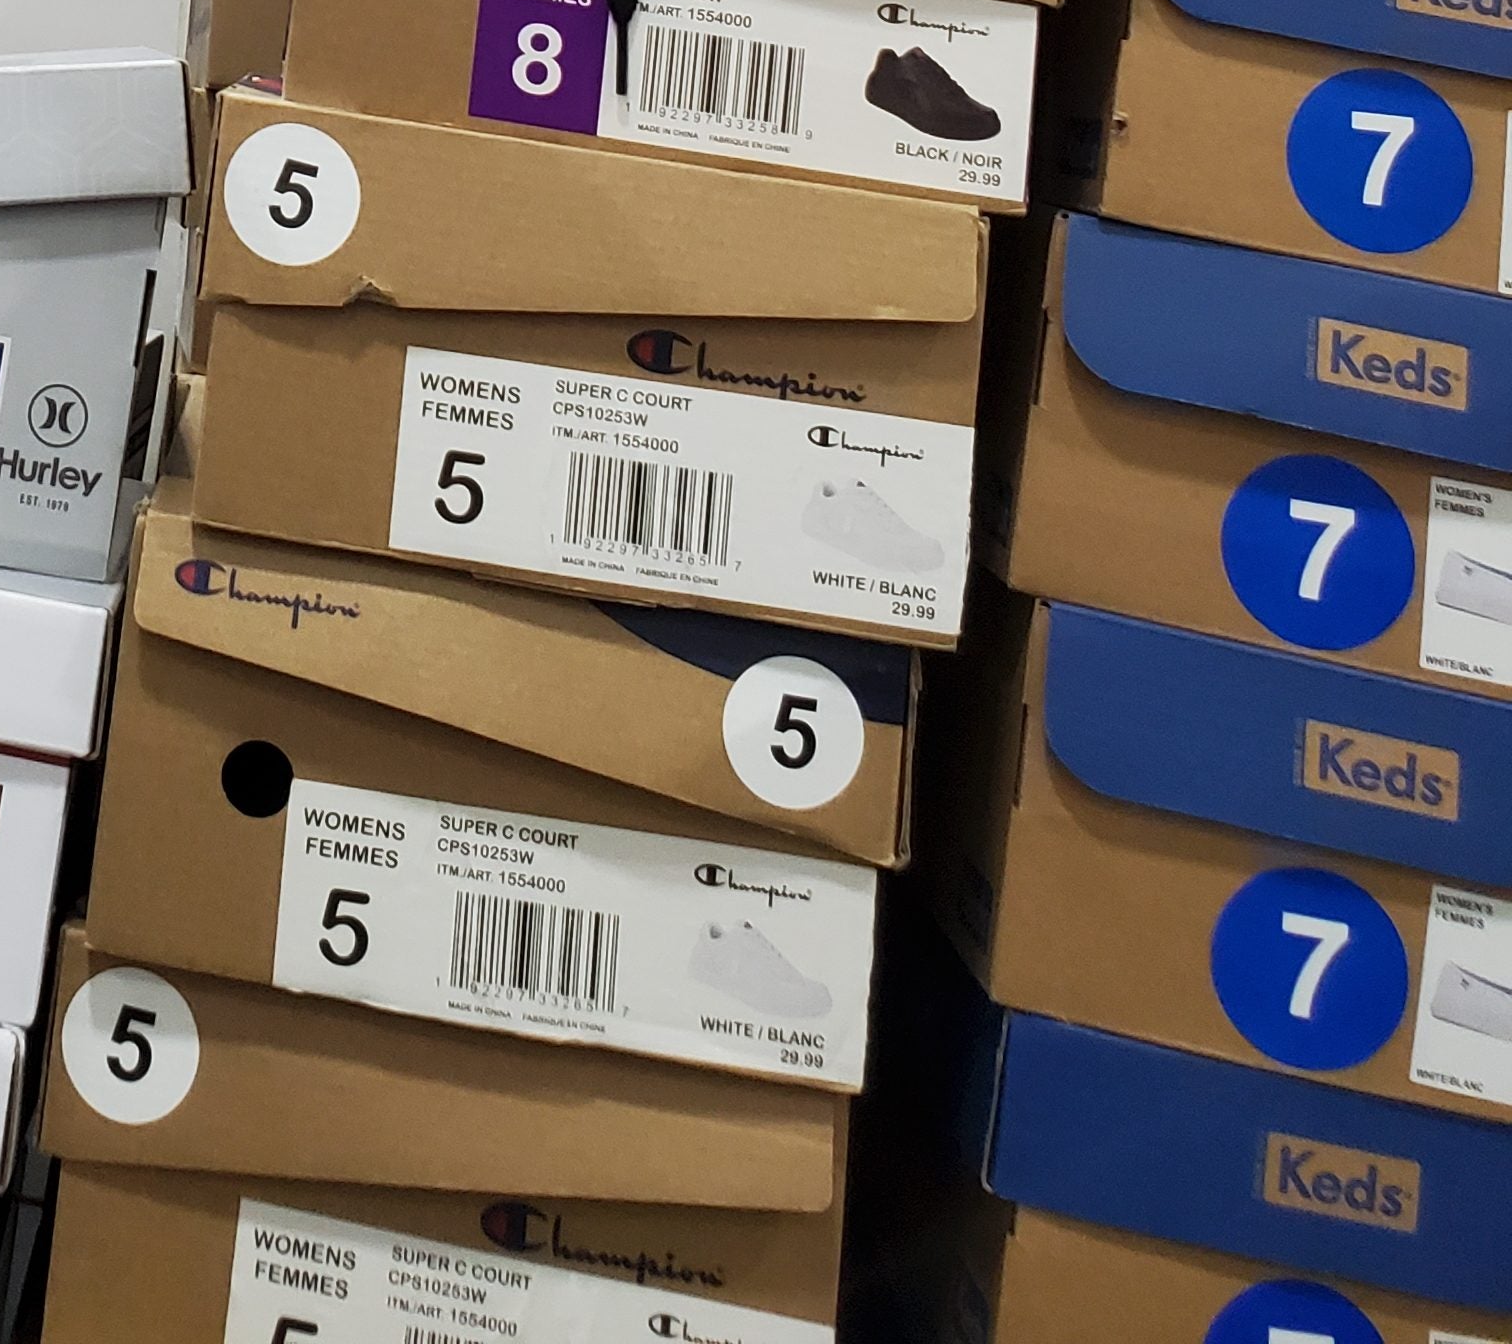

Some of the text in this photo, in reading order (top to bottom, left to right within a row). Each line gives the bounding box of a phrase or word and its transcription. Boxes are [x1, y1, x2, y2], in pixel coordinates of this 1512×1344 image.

[687, 7, 752, 29] 1554000
[877, 3, 990, 42] Champion
[511, 23, 563, 96] 8
[895, 141, 1002, 170] BLACK NOIR
[1351, 111, 1415, 206] 7
[268, 158, 319, 230] 5
[958, 169, 1001, 187] 29.99
[626, 329, 866, 403] Champion
[1330, 329, 1452, 397] Keds
[420, 372, 521, 404] WOMENS
[555, 379, 693, 412] SUPER C COURT
[421, 400, 514, 431] FEMMES
[552, 401, 649, 427] CPS10253W
[614, 432, 679, 454] 1554000
[807, 425, 924, 467] Champion
[434, 449, 486, 525] 5
[1290, 498, 1355, 601] 7
[174, 558, 361, 630] Champion
[813, 571, 937, 602] WHITE BLANC
[892, 601, 936, 620] 29.99
[769, 693, 818, 770] 5
[1318, 733, 1444, 806] Keds
[304, 807, 406, 841] WOMENS
[440, 815, 579, 850] SUPER C COURT
[305, 837, 399, 869] FEMMES
[437, 838, 535, 864] CPS10253W
[498, 870, 566, 894] 1554000
[694, 863, 812, 908] Champion
[318, 888, 370, 966] 5
[1282, 911, 1349, 1019] 7
[105, 1003, 157, 1083] 5
[700, 1015, 825, 1049] WHITE BLANC
[780, 1048, 824, 1069] 29.99
[1279, 1145, 1403, 1217] Keds
[254, 1227, 357, 1271] WOMENS
[480, 1201, 724, 1287] Champion
[255, 1259, 349, 1300] FEMMES
[392, 1245, 532, 1292] SUPER C COURT
[450, 1308, 518, 1337] 1554000
